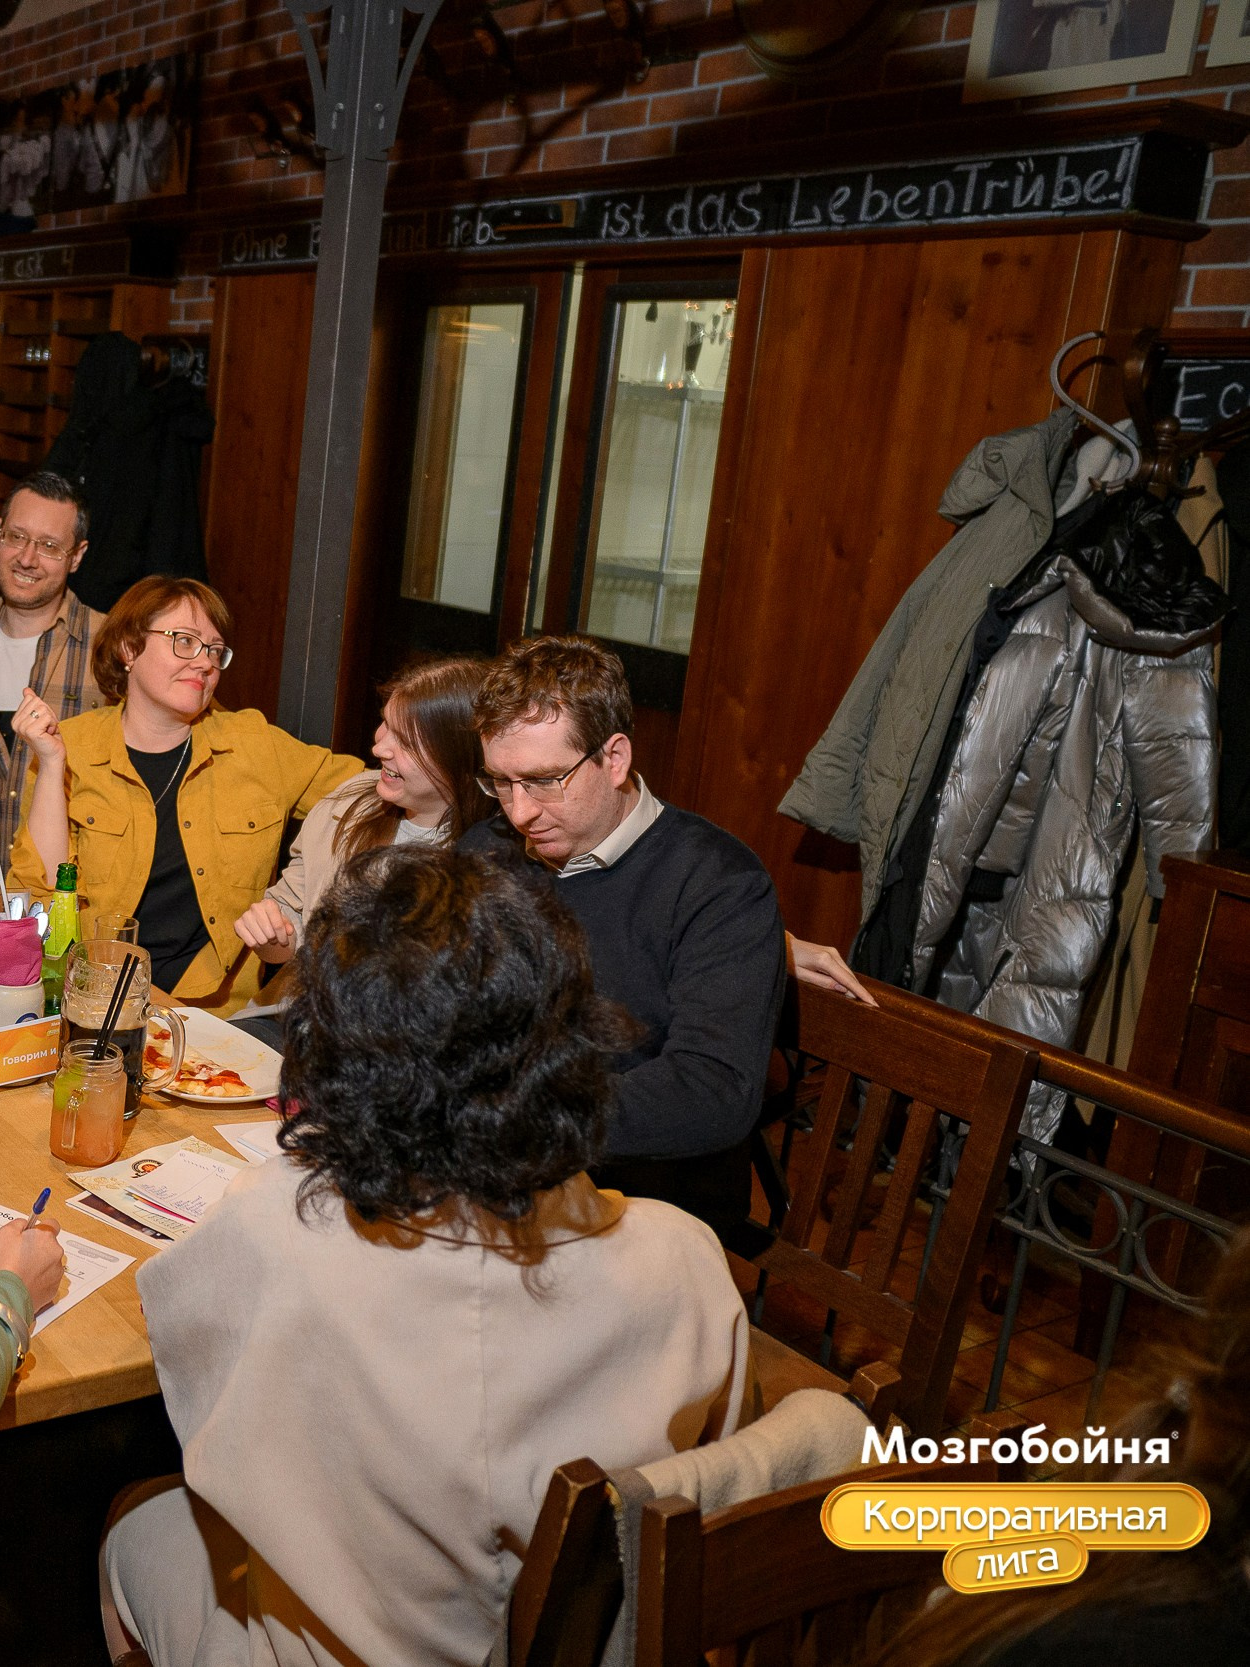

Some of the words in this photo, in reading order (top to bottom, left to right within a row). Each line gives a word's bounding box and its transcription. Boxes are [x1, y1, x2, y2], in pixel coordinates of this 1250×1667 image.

[232, 230, 288, 263] Ohne
[599, 194, 649, 239] ist
[2, 1049, 48, 1067] Говорим
[50, 1047, 57, 1055] и
